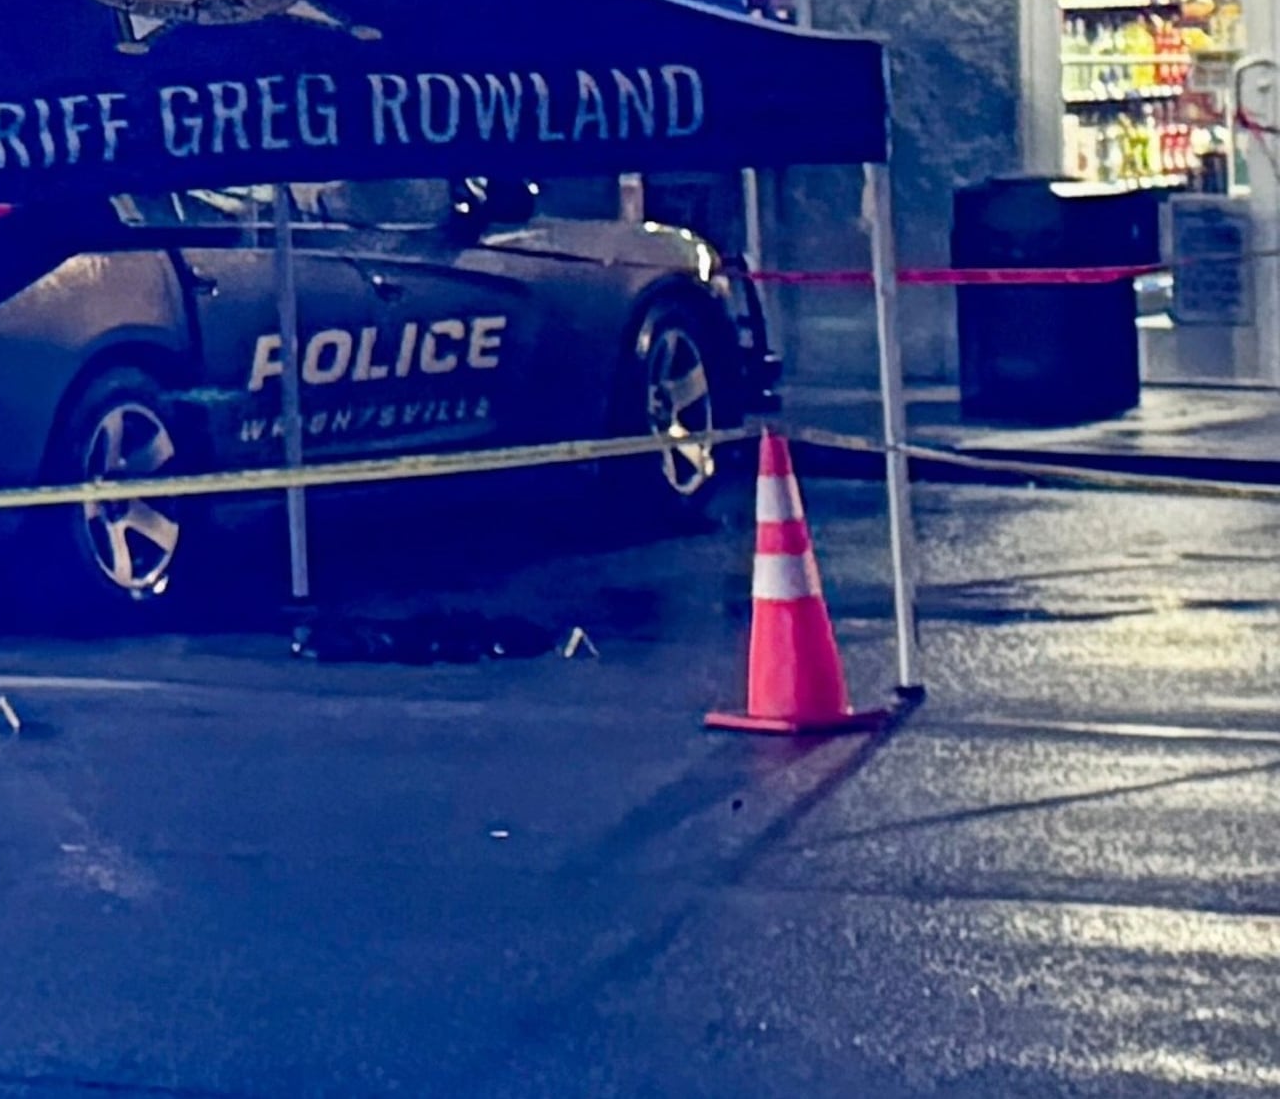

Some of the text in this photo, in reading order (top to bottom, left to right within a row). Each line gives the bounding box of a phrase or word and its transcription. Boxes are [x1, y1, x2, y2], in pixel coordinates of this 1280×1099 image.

[159, 73, 339, 157] GREG
[367, 64, 705, 146] ROWLAND
[247, 315, 507, 391] POLICE
